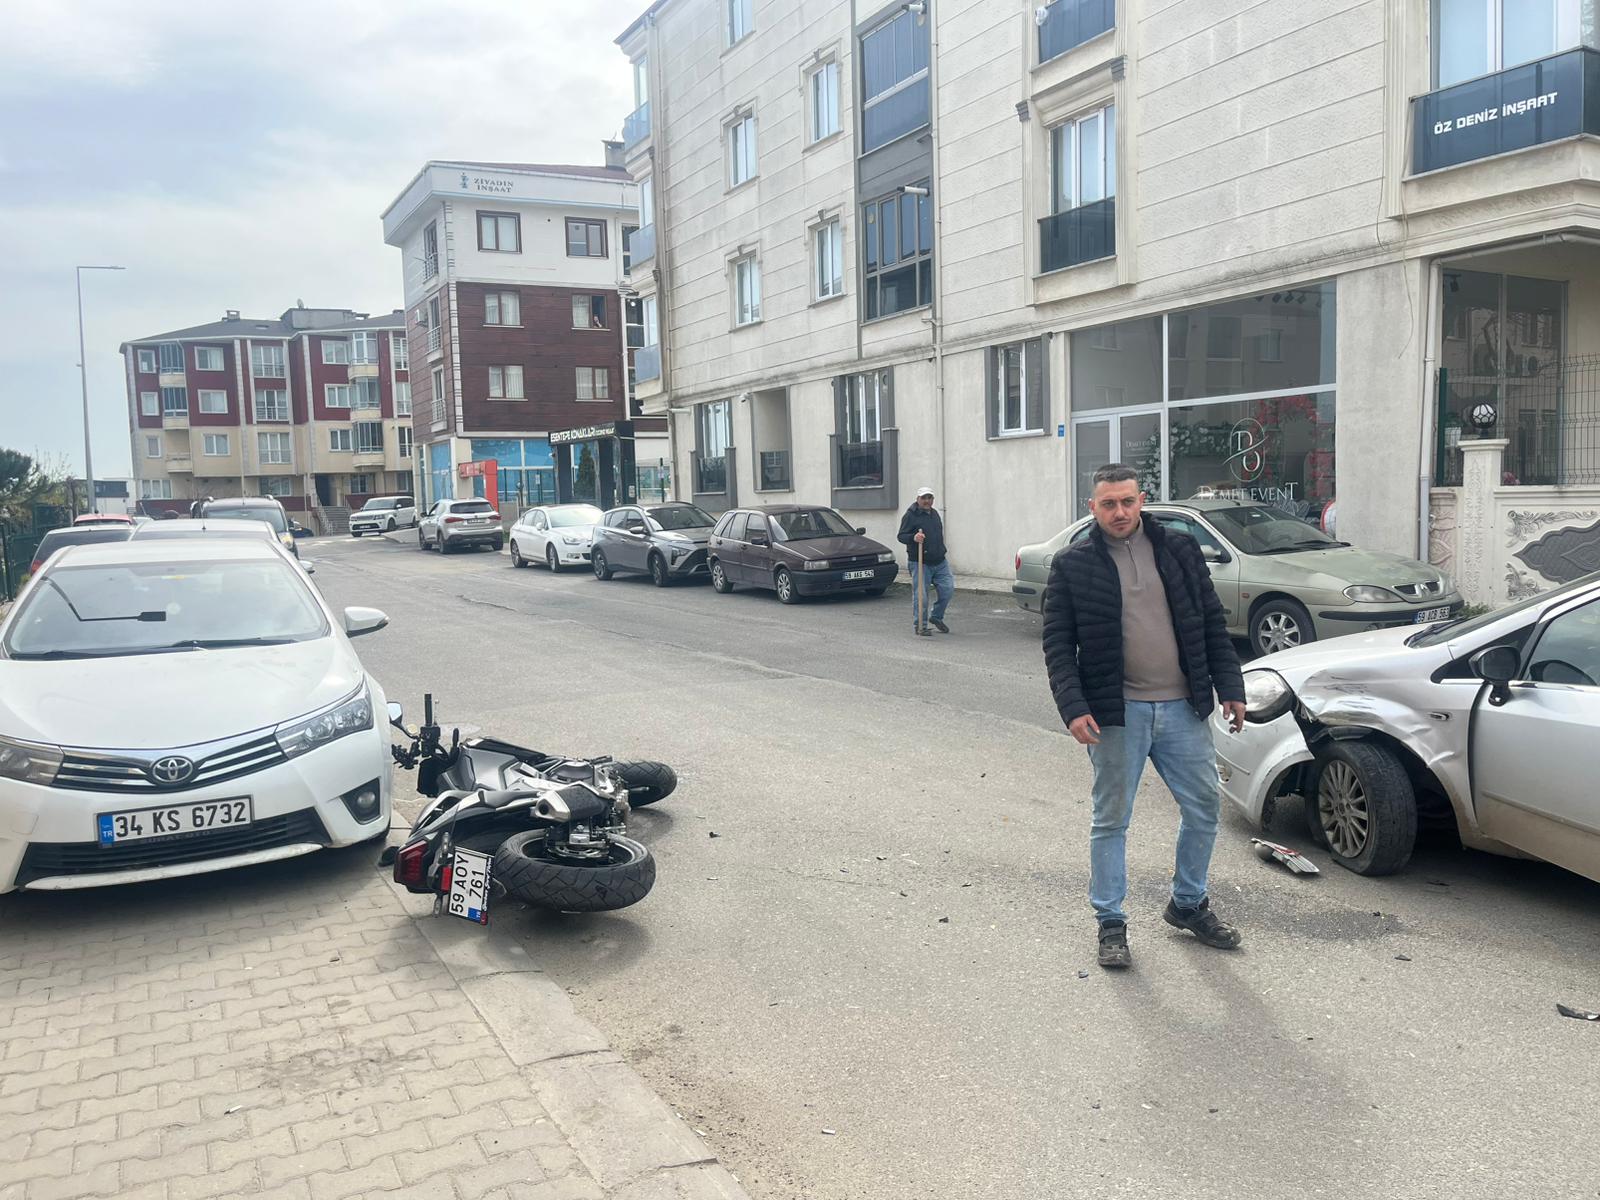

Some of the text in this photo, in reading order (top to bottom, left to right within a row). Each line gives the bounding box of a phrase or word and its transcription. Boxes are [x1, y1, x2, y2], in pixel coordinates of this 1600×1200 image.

[1434, 92, 1558, 135] ÖZ DENİZ İNŞAAT
[103, 830, 113, 838] TR
[115, 802, 247, 838] 34 KS 6732
[451, 854, 469, 913] 59 AOY
[468, 870, 484, 899] 761
